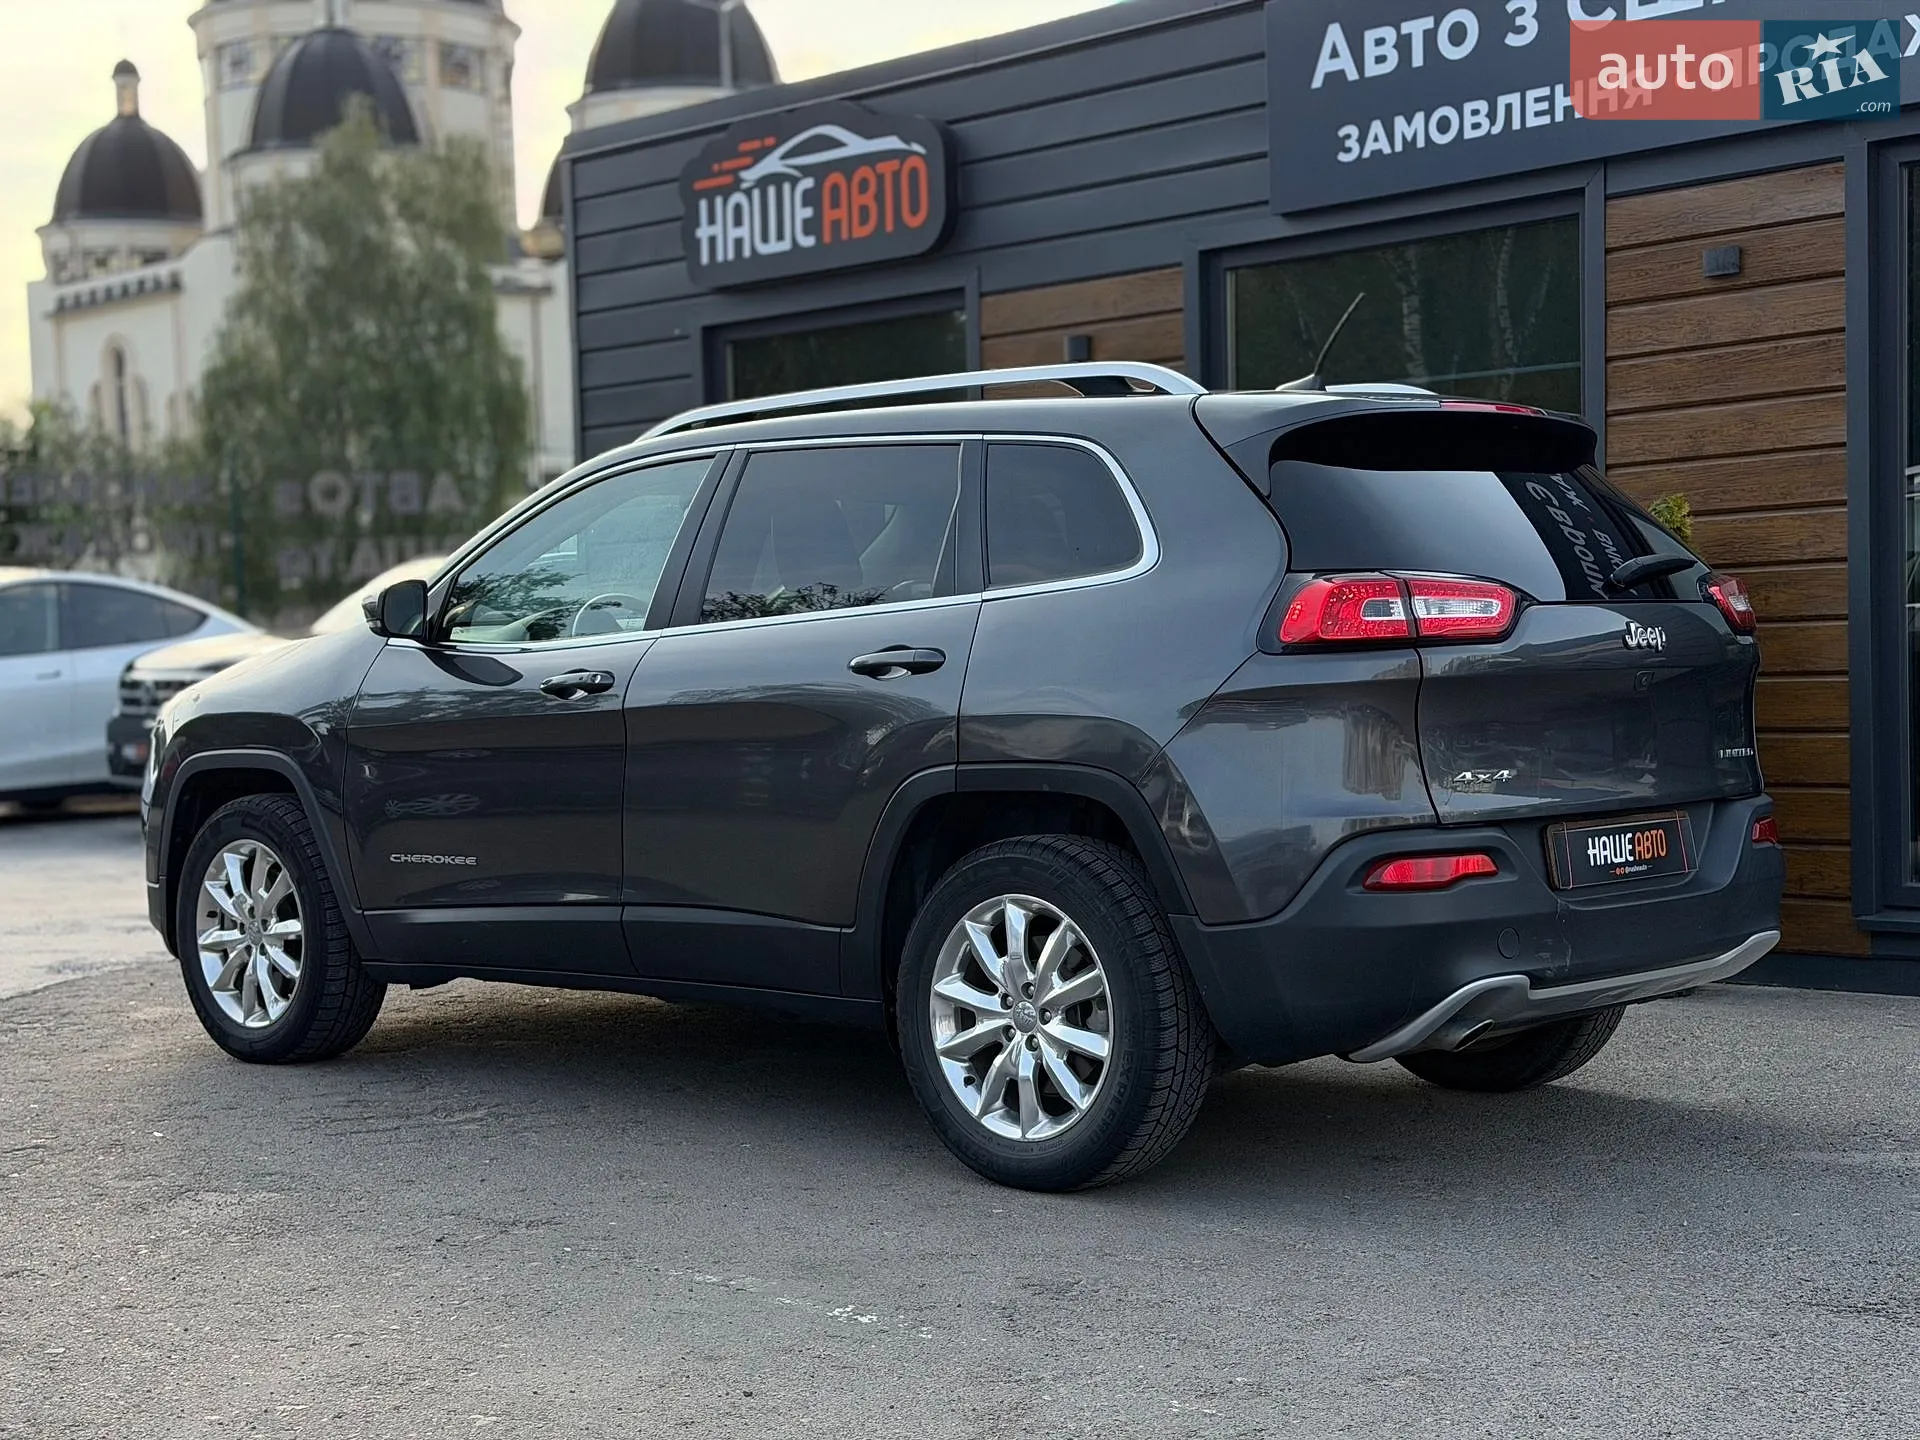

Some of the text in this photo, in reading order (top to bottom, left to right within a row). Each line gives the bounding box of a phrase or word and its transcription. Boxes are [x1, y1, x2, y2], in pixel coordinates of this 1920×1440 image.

[1336, 65, 1653, 163] ЗАМОВЛЕННЯ
[695, 154, 930, 266] НАШЕ АВТО
[1624, 621, 1667, 651] Jeep
[389, 853, 478, 866] CHEROKEE
[1634, 829, 1667, 861] АВТО
